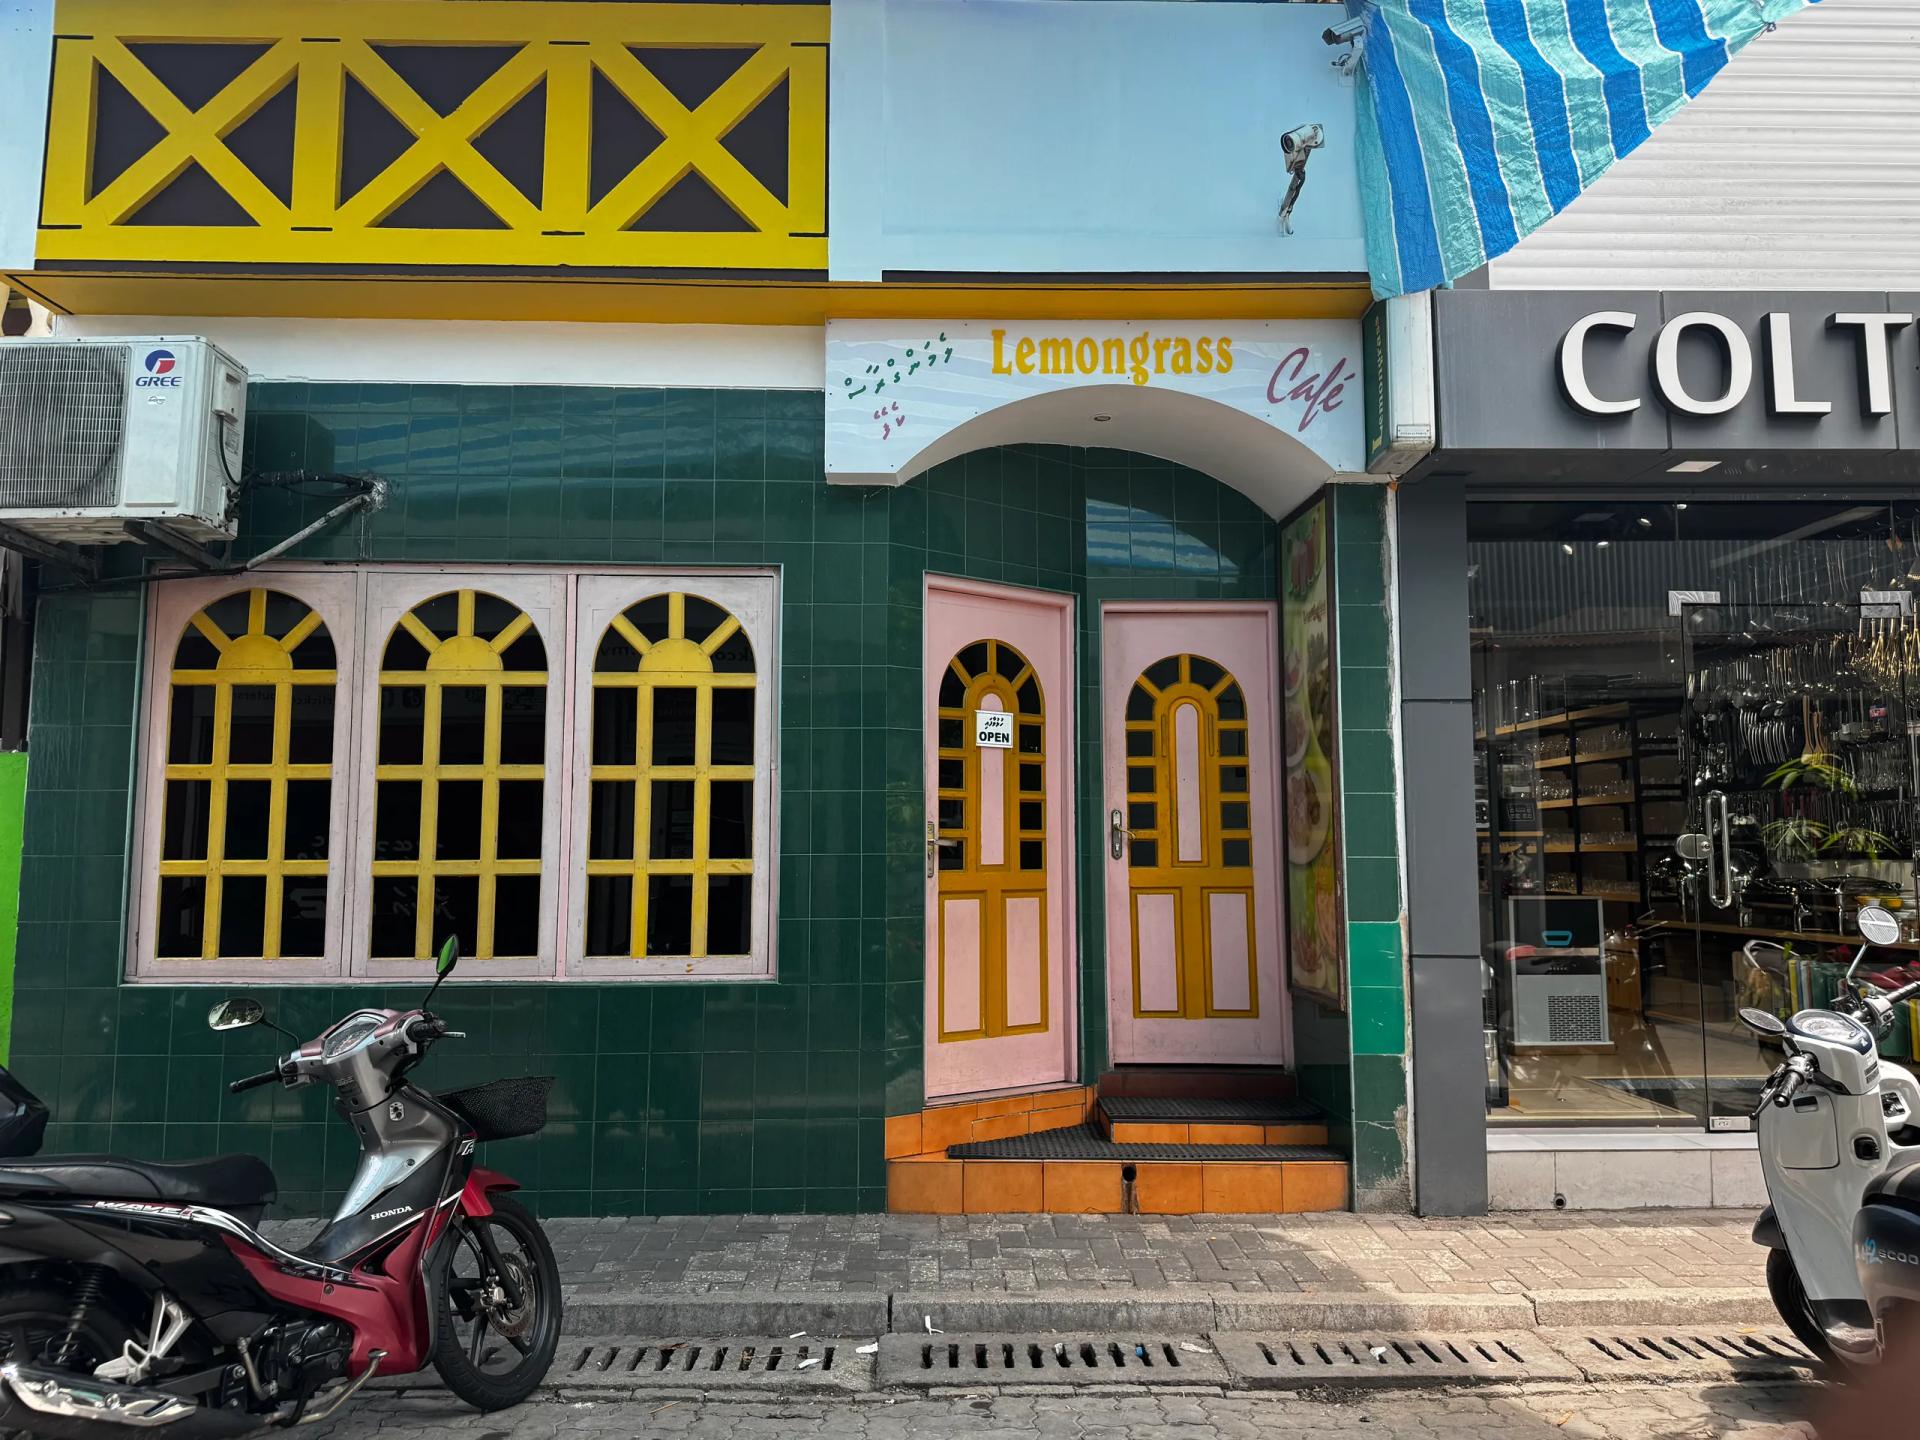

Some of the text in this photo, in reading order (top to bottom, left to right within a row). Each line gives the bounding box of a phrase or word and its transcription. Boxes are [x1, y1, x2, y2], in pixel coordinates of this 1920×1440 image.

[135, 376, 183, 387] GREE
[990, 329, 1356, 432] Lemongrass Café
[978, 731, 1010, 744] OPEN
[370, 1205, 413, 1220] HONDA
